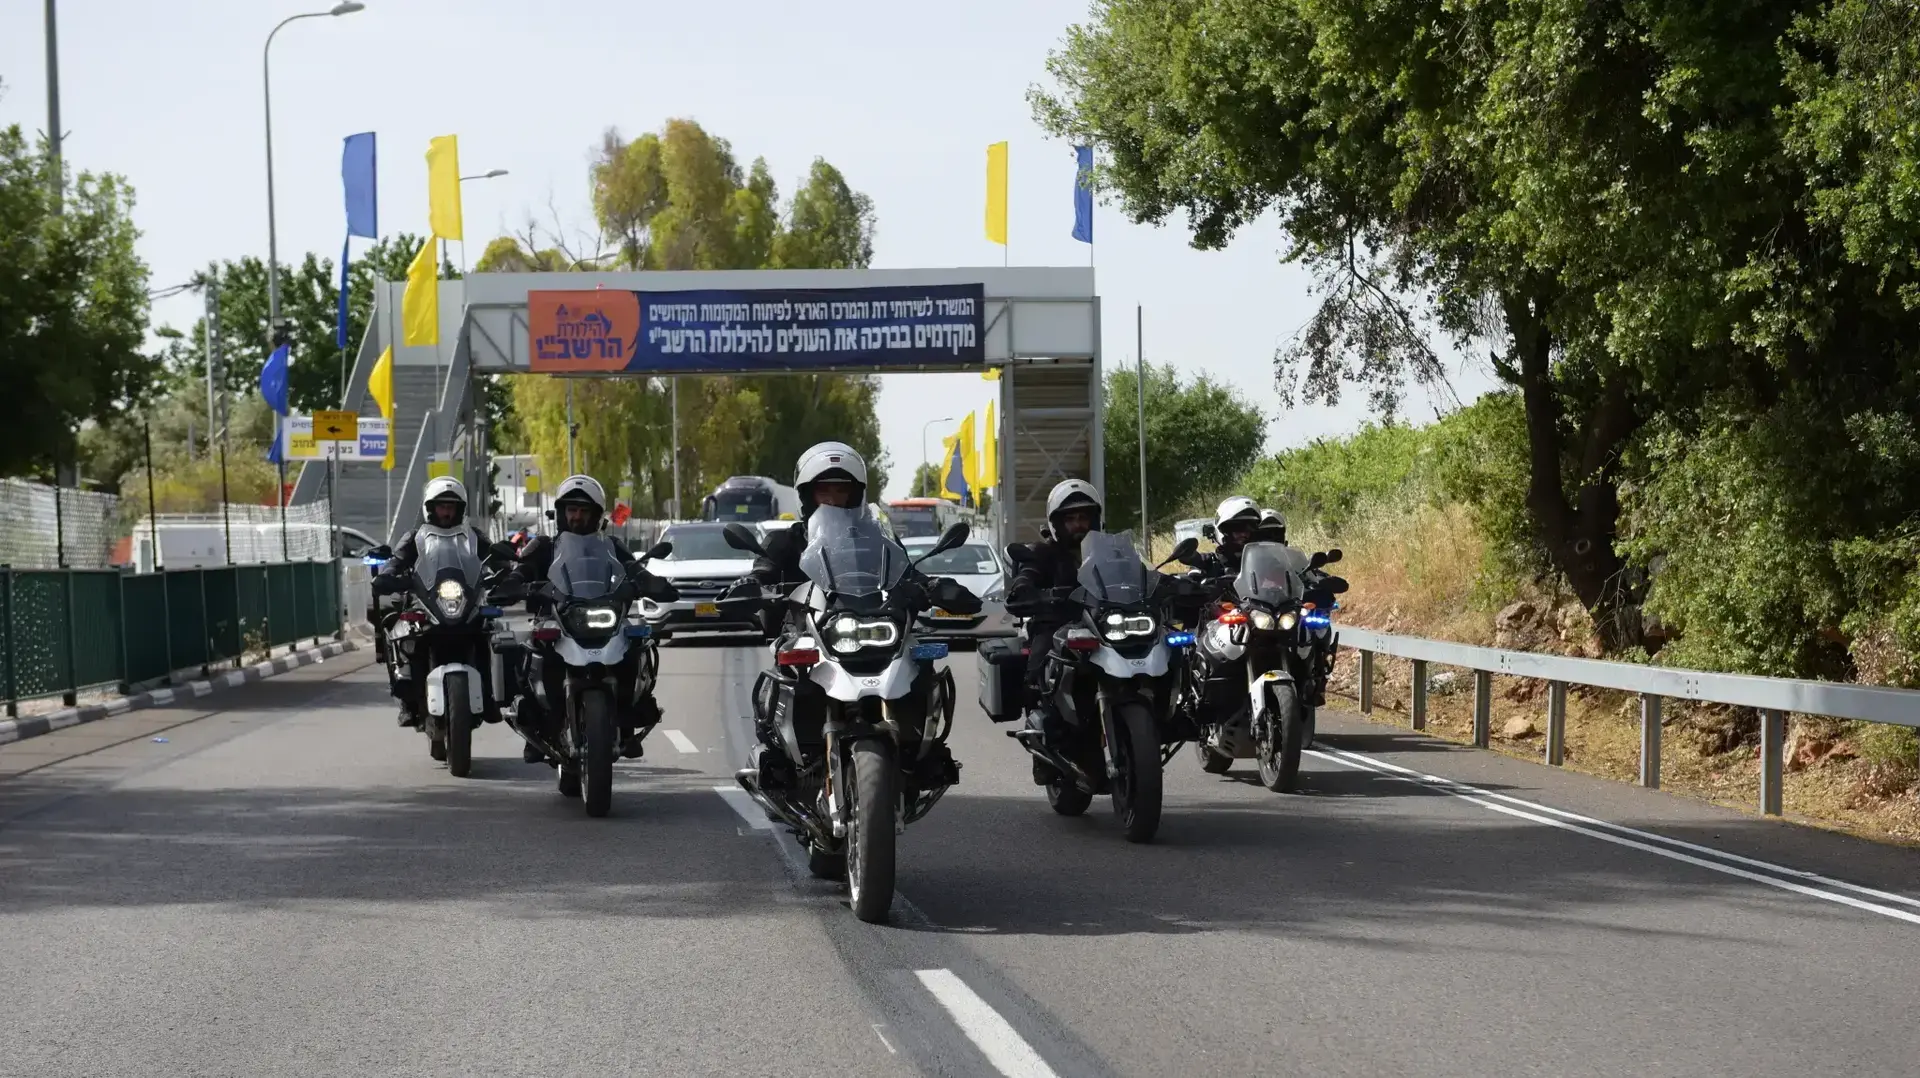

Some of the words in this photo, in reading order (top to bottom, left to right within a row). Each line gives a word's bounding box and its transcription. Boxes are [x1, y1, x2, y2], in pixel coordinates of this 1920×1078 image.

[649, 303, 698, 327] הקדושים
[700, 303, 750, 327] המקומות
[752, 299, 792, 322] לפיתוח
[793, 302, 829, 322] הארצי
[830, 302, 870, 321] והמרכז
[871, 301, 888, 319] דת
[889, 296, 934, 318] לשירותי
[935, 298, 975, 317] המשרד
[709, 323, 773, 353] להילולת
[776, 323, 831, 353] העולים
[834, 326, 858, 351] את
[860, 325, 912, 350] בברכה
[914, 323, 976, 355] מקדמים
[327, 445, 353, 454] בצע
[361, 437, 387, 450] כחול
